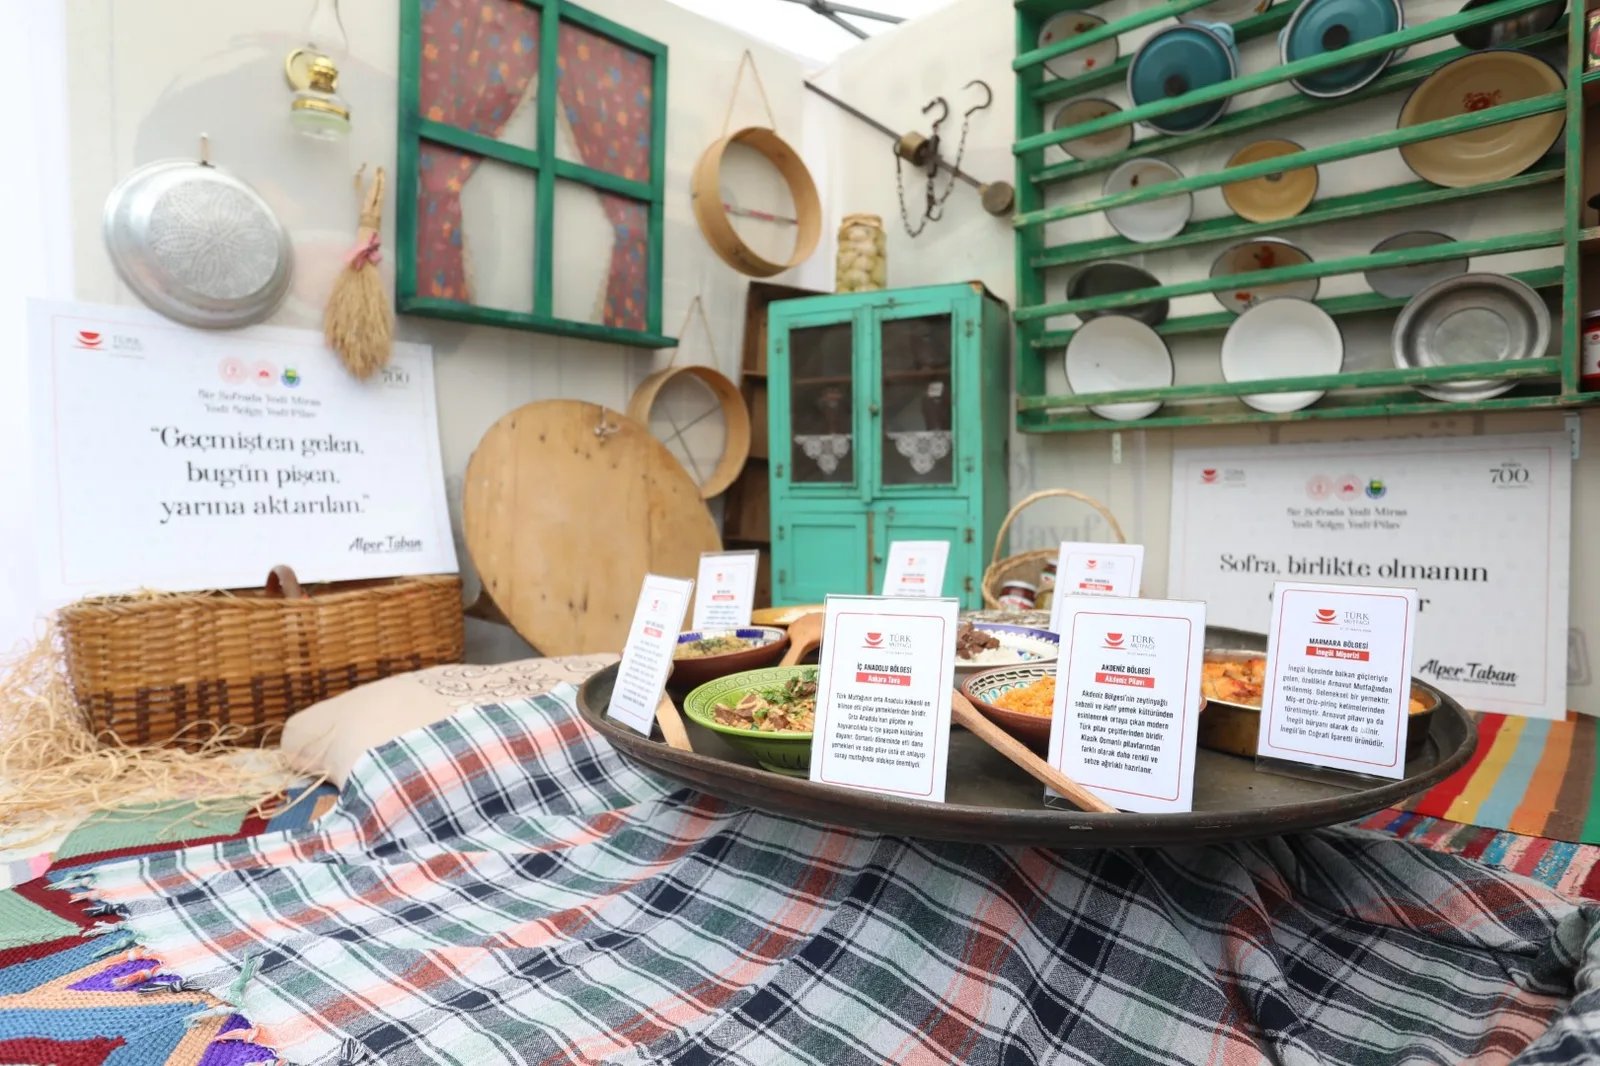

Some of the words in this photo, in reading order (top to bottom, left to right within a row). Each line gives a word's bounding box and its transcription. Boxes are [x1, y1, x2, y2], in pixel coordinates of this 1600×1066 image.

[187, 461, 268, 487] bugün
[160, 502, 244, 524] yarına
[1288, 556, 1370, 576] birlikte
[1378, 559, 1487, 582] olmanın
[1344, 611, 1370, 621] TÜRK
[1131, 635, 1155, 644] TÜRK
[1309, 638, 1341, 647] MARMARA
[1343, 640, 1369, 650] BÖLGESİ
[1316, 647, 1334, 657] İnegöl
[1101, 664, 1126, 673] AKDENİZ
[1126, 665, 1151, 675] BÖLGESİ
[1288, 664, 1306, 673] İnegöl
[1334, 670, 1356, 679] balkan
[1356, 673, 1388, 683] göçleriyle
[1420, 659, 1463, 680] Alper
[1466, 662, 1518, 682] Taban
[1105, 675, 1127, 684] Akdeniz
[1128, 677, 1145, 686] Pilavı
[1301, 677, 1326, 686] özellikle
[1327, 679, 1352, 689] Arnavut
[1353, 682, 1393, 694] Mutfağından
[1081, 690, 1103, 699] Akdeniz
[1136, 697, 1168, 708] zeytinyağlı
[1316, 688, 1349, 699] Geleneksel
[1360, 695, 1390, 705] yemektir.
[1075, 701, 1094, 709] sebzeli
[1138, 707, 1174, 719] kültüründen
[1339, 702, 1385, 715] kelimelerinden
[1077, 712, 1108, 722] esinlenerek
[1110, 716, 1128, 725] ortaya
[1129, 718, 1145, 727] çıkan
[1146, 721, 1169, 730] modern
[1286, 715, 1304, 725] İnegöl
[1329, 722, 1349, 732] olarak
[1350, 725, 1358, 733] da
[1322, 710, 1346, 720] Arnavut
[1347, 714, 1365, 722] pilavı
[1366, 717, 1374, 725] ya
[1375, 718, 1384, 726] da
[1079, 722, 1091, 731] Türk
[1092, 725, 1106, 733] pilav
[1107, 727, 1144, 738] çeşitlerinden
[1308, 729, 1330, 739] Coğrafi
[1331, 732, 1353, 743] İşaretli
[1354, 736, 1385, 748] ürünüdür.
[1080, 734, 1098, 742] Klasik
[1099, 736, 1122, 746] Osmanlı
[1122, 740, 1161, 752] pilavlarından
[1081, 745, 1096, 754] farklı
[1097, 748, 1115, 757] olarak
[1116, 750, 1131, 759] daha
[1131, 754, 1149, 762] renkli
[1150, 756, 1158, 764] ve
[1084, 757, 1100, 766] sebze
[1124, 763, 1153, 775] hazırlanır.
